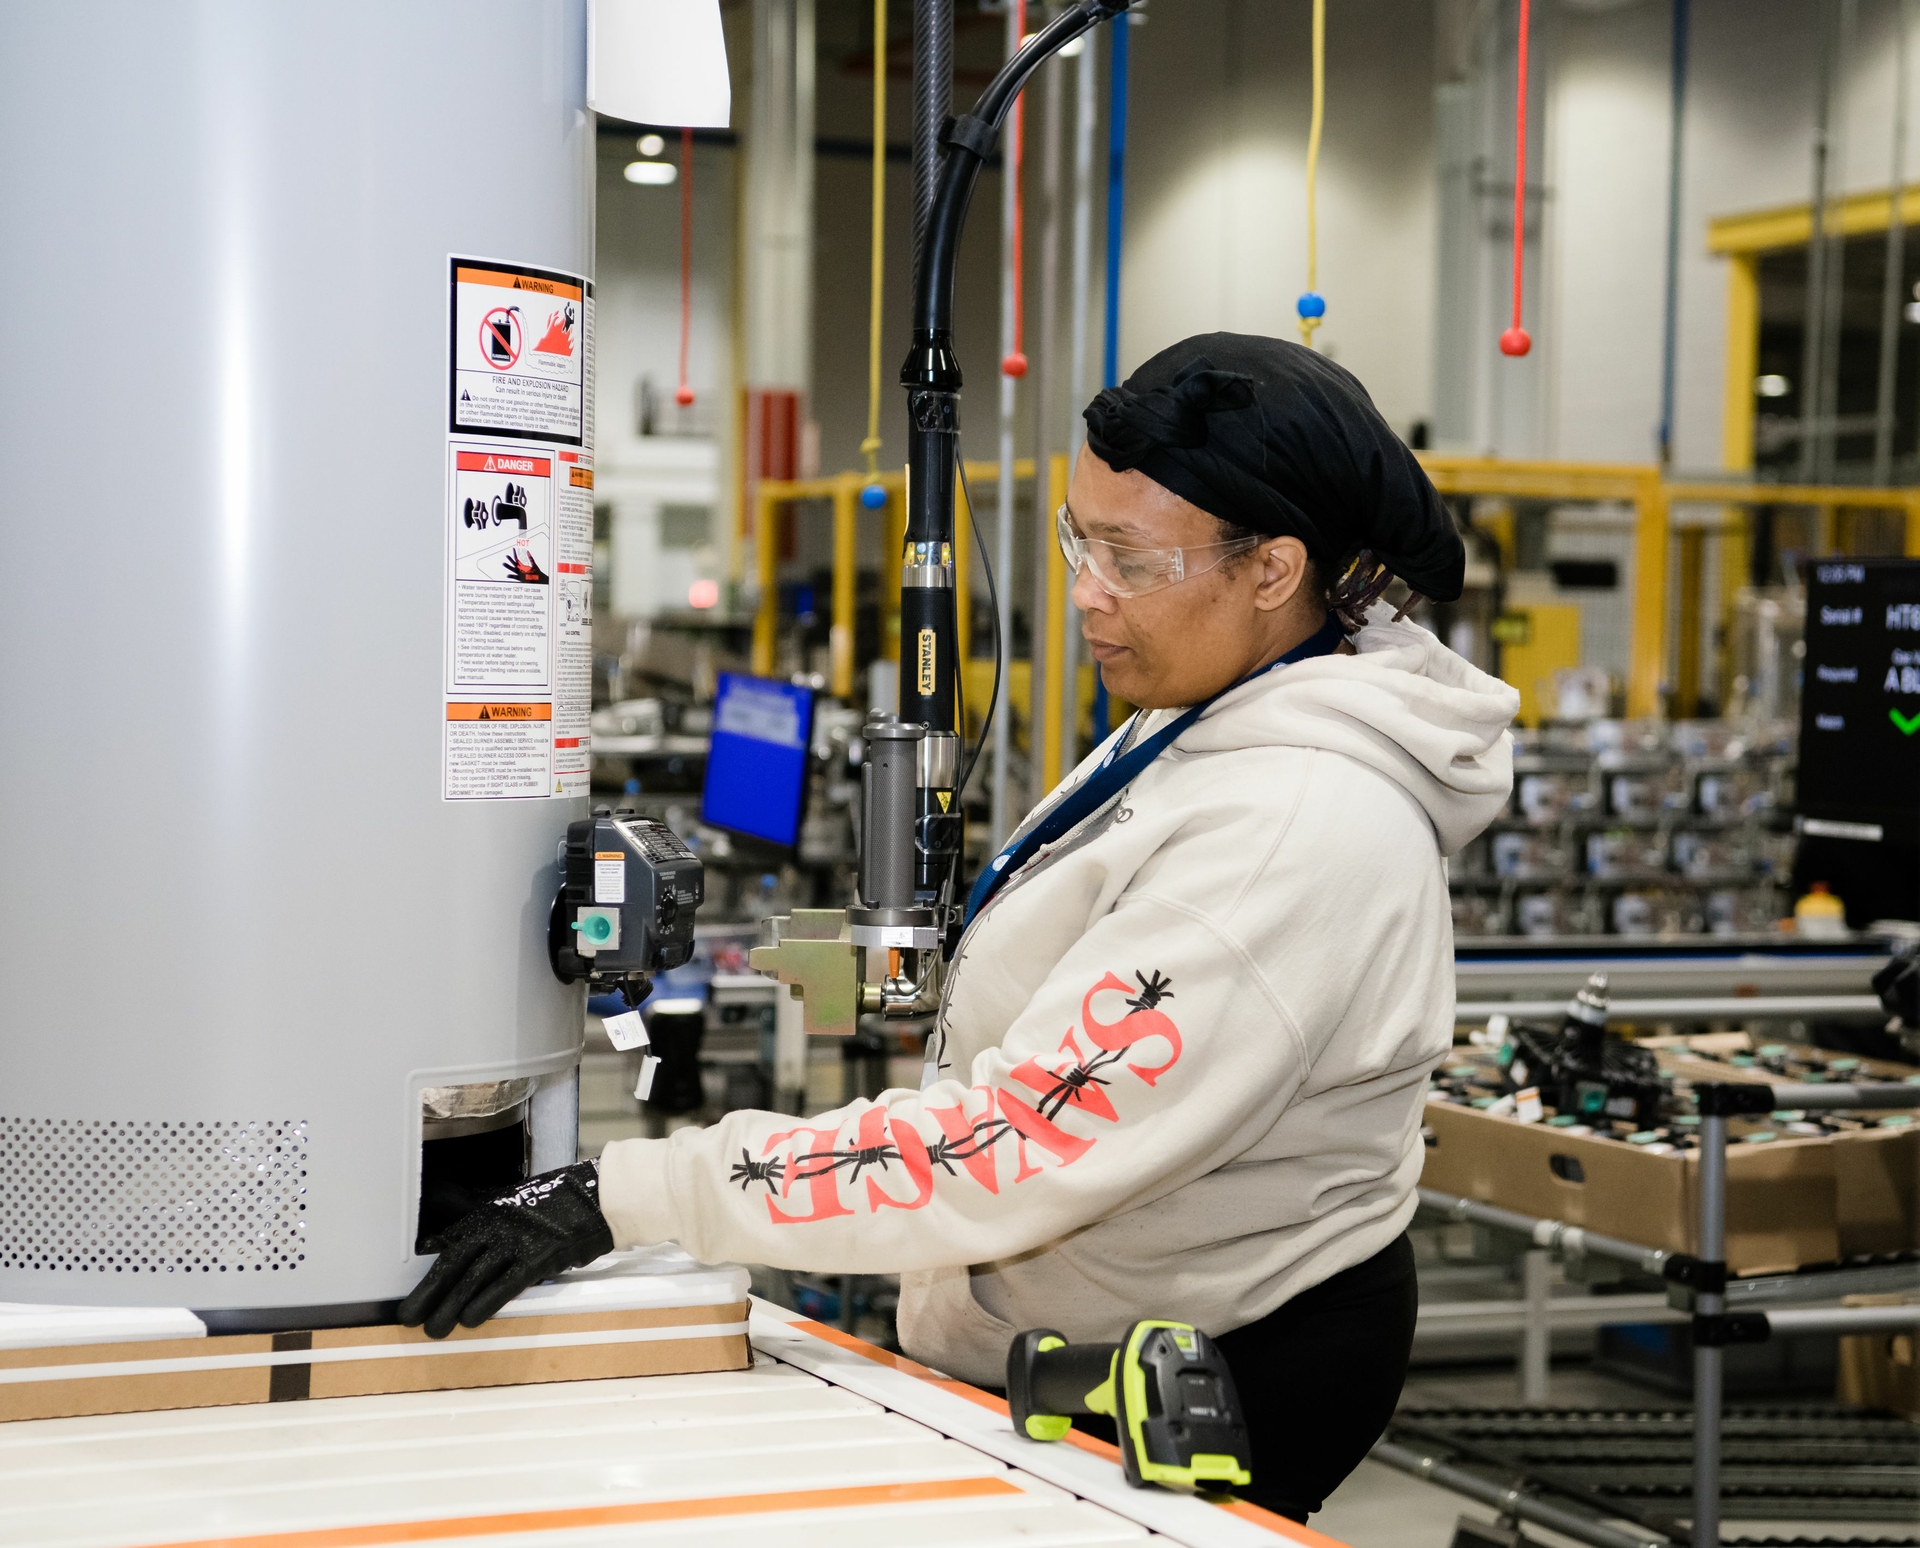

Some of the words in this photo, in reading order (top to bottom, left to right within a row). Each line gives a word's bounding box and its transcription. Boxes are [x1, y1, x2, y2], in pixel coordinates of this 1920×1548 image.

[522, 279, 554, 294] WARNING
[492, 376, 506, 384] FIRE
[507, 377, 521, 386] AND
[522, 379, 551, 390] EXPLOSION
[552, 383, 569, 392] HAZARD
[460, 416, 482, 424] appliance
[498, 458, 534, 472] DANGER
[922, 634, 931, 691] STANLEY
[492, 706, 532, 717] WARNING
[761, 970, 1182, 1224] SAVAGE
